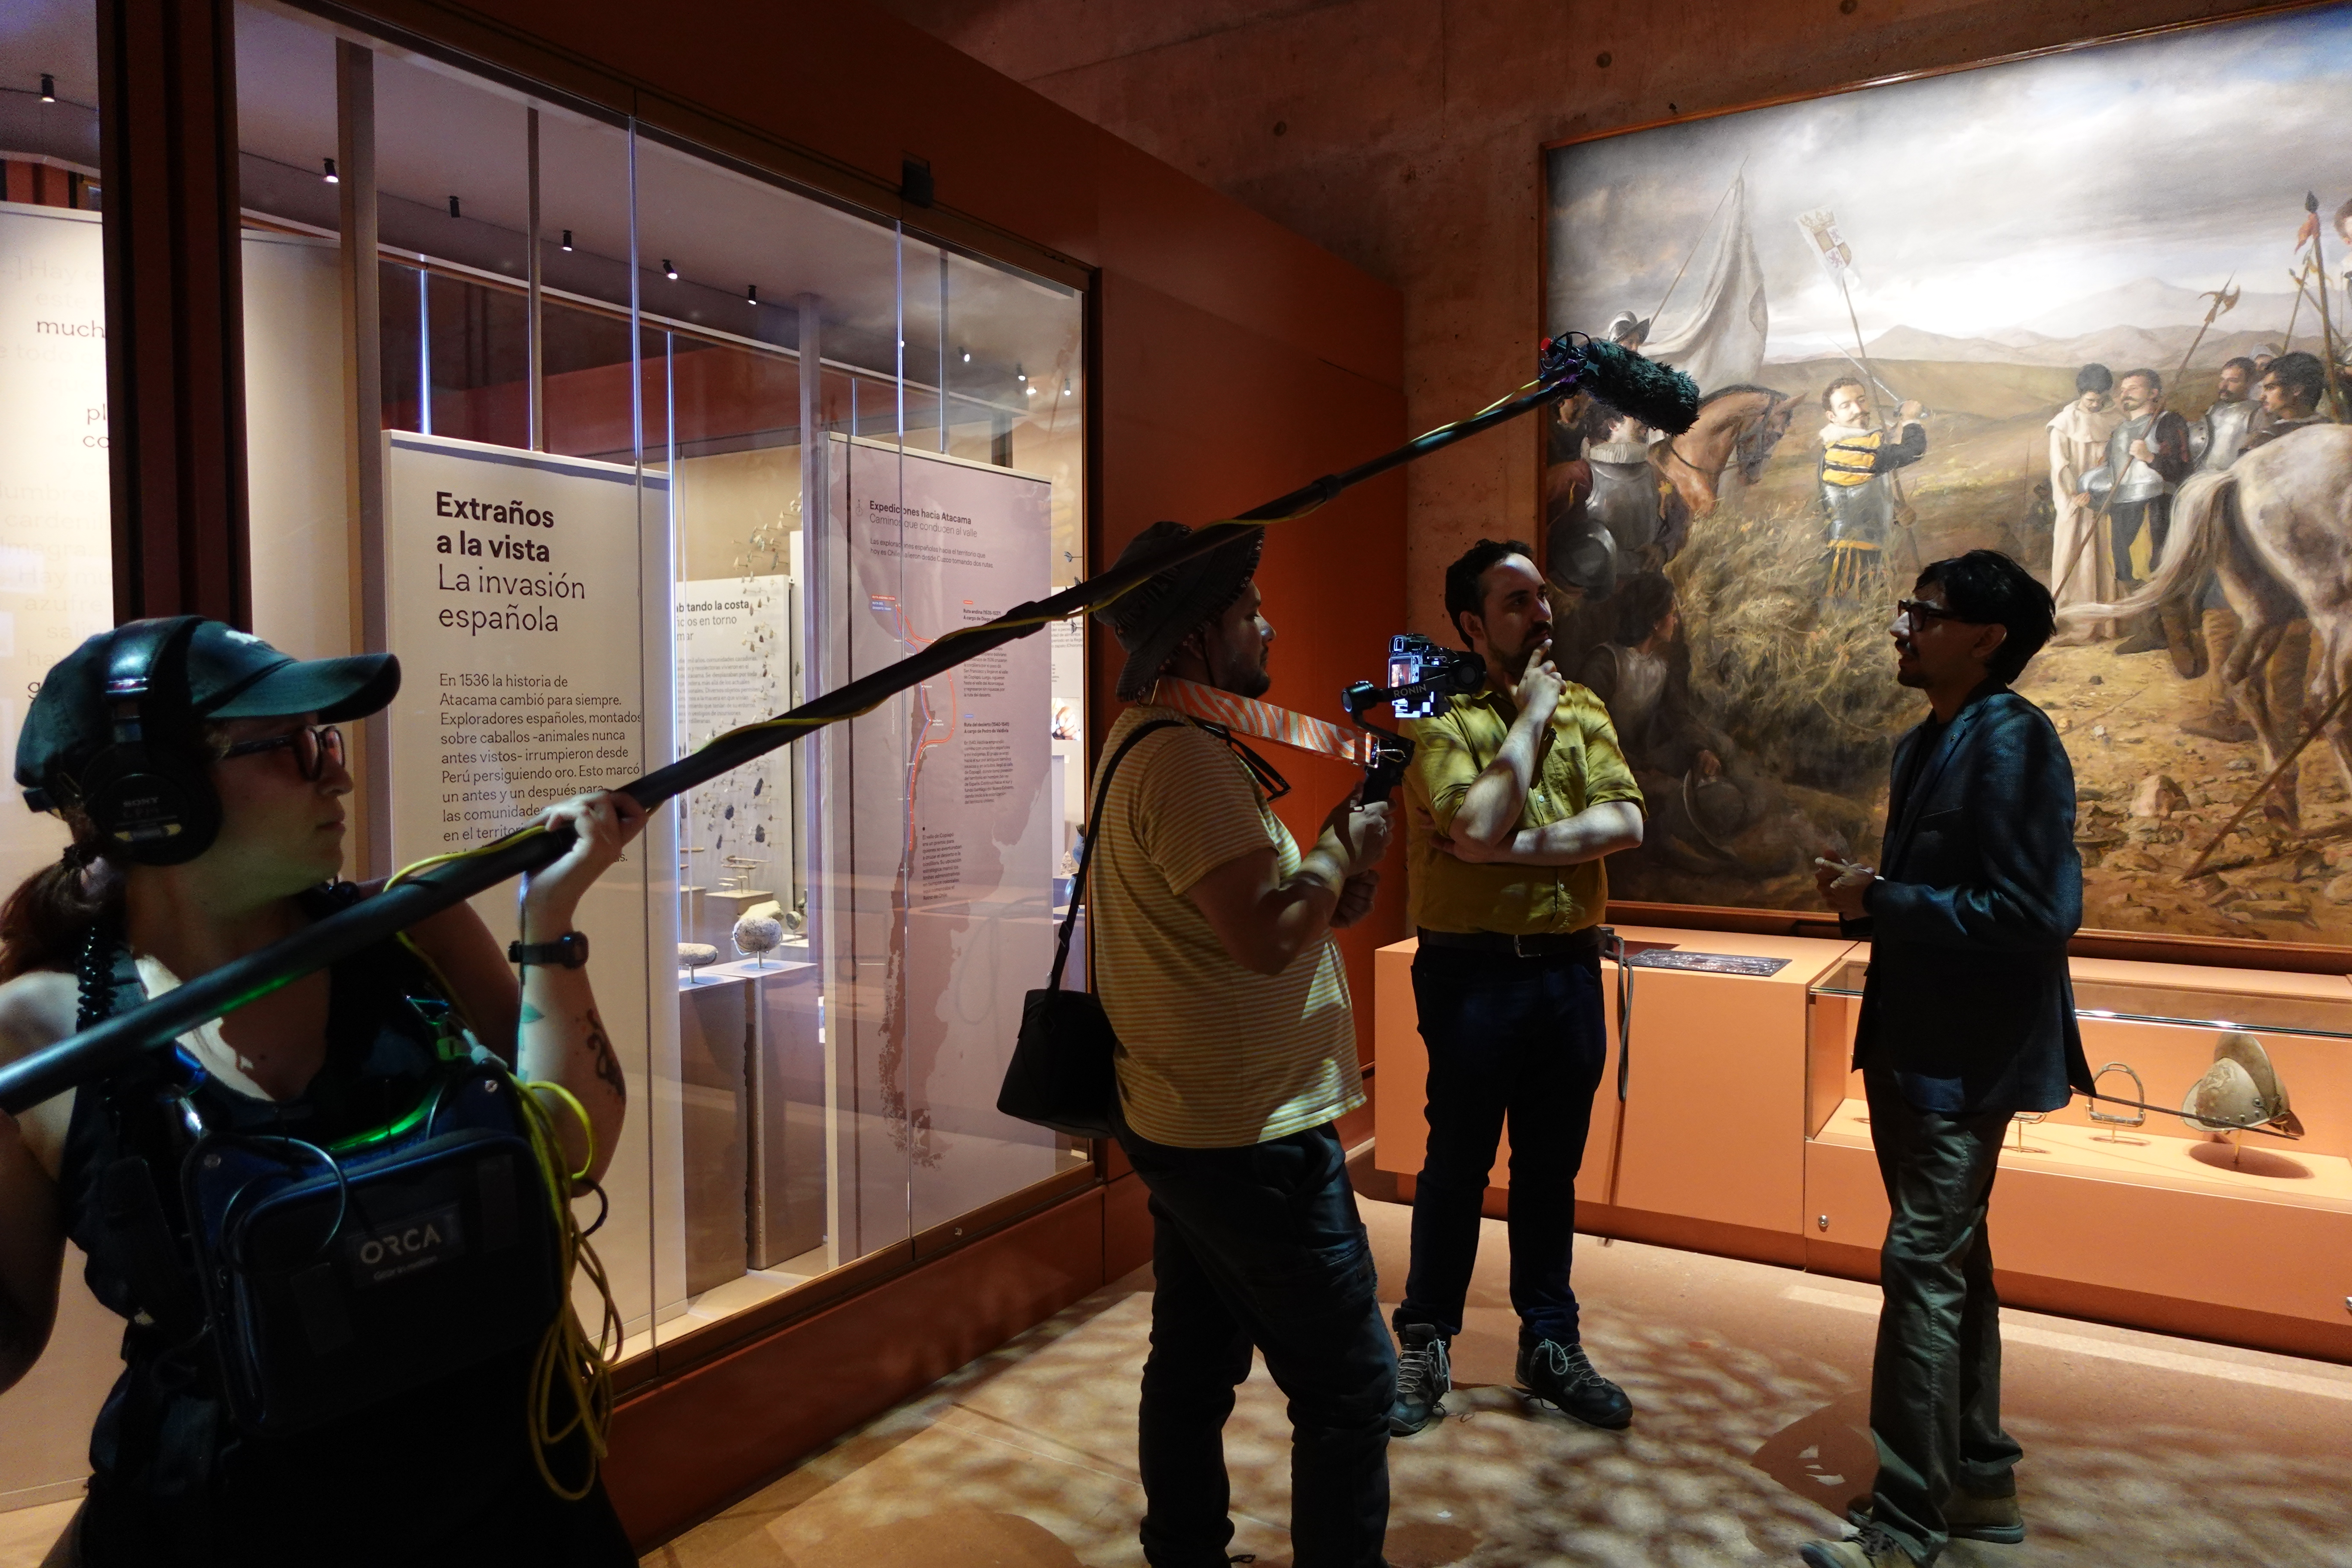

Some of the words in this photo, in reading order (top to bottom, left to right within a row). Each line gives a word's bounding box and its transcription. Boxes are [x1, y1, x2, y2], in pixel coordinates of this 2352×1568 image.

[36, 319, 104, 339] much
[437, 491, 554, 528] Extraños
[870, 500, 919, 517] Expedicones
[921, 509, 940, 520] hacia
[941, 512, 971, 524] Atacama
[4, 511, 110, 530] cardenill
[904, 520, 918, 529] que
[920, 522, 954, 534] conducen
[956, 526, 961, 535] al
[963, 528, 977, 537] valle
[437, 534, 451, 554] a
[460, 530, 482, 556] la
[489, 534, 549, 562] vista
[903, 551, 920, 560] alieron
[952, 557, 972, 565] tomando
[439, 564, 470, 591] La
[479, 567, 585, 599] invasión
[715, 600, 722, 610] la
[725, 600, 749, 609] costa
[439, 603, 558, 636] española
[700, 617, 710, 626] en
[713, 616, 736, 625] torno
[440, 673, 456, 686] En
[459, 674, 489, 686] 1536
[493, 675, 502, 686] la
[506, 675, 551, 687] historia
[554, 676, 568, 687] de
[1393, 684, 1427, 698] RONIN
[440, 693, 496, 706] Atacama
[500, 693, 544, 706] cambió
[548, 696, 573, 708] para
[575, 694, 621, 708] siempre.
[441, 712, 524, 728] Exploradores
[527, 712, 586, 728] españoles,
[441, 732, 477, 744] sobre
[480, 730, 530, 744] caballos
[533, 730, 589, 741] -animales
[592, 731, 625, 741] nunca
[441, 751, 477, 763] antes
[480, 750, 522, 763] vistos-
[526, 747, 594, 764] irrumpieron
[597, 746, 628, 758] desde
[442, 769, 470, 783] Perú
[474, 766, 551, 785] persiguiendo
[555, 769, 576, 778] oro.
[579, 766, 603, 777] Esto
[606, 763, 639, 775] marcó
[443, 793, 458, 802] un
[462, 790, 496, 802] antes
[499, 790, 507, 802] y
[510, 789, 525, 798] un
[528, 783, 576, 799] después
[444, 810, 460, 822] las
[444, 831, 459, 841] en
[462, 828, 472, 840] el
[360, 1223, 442, 1265] ORCA
